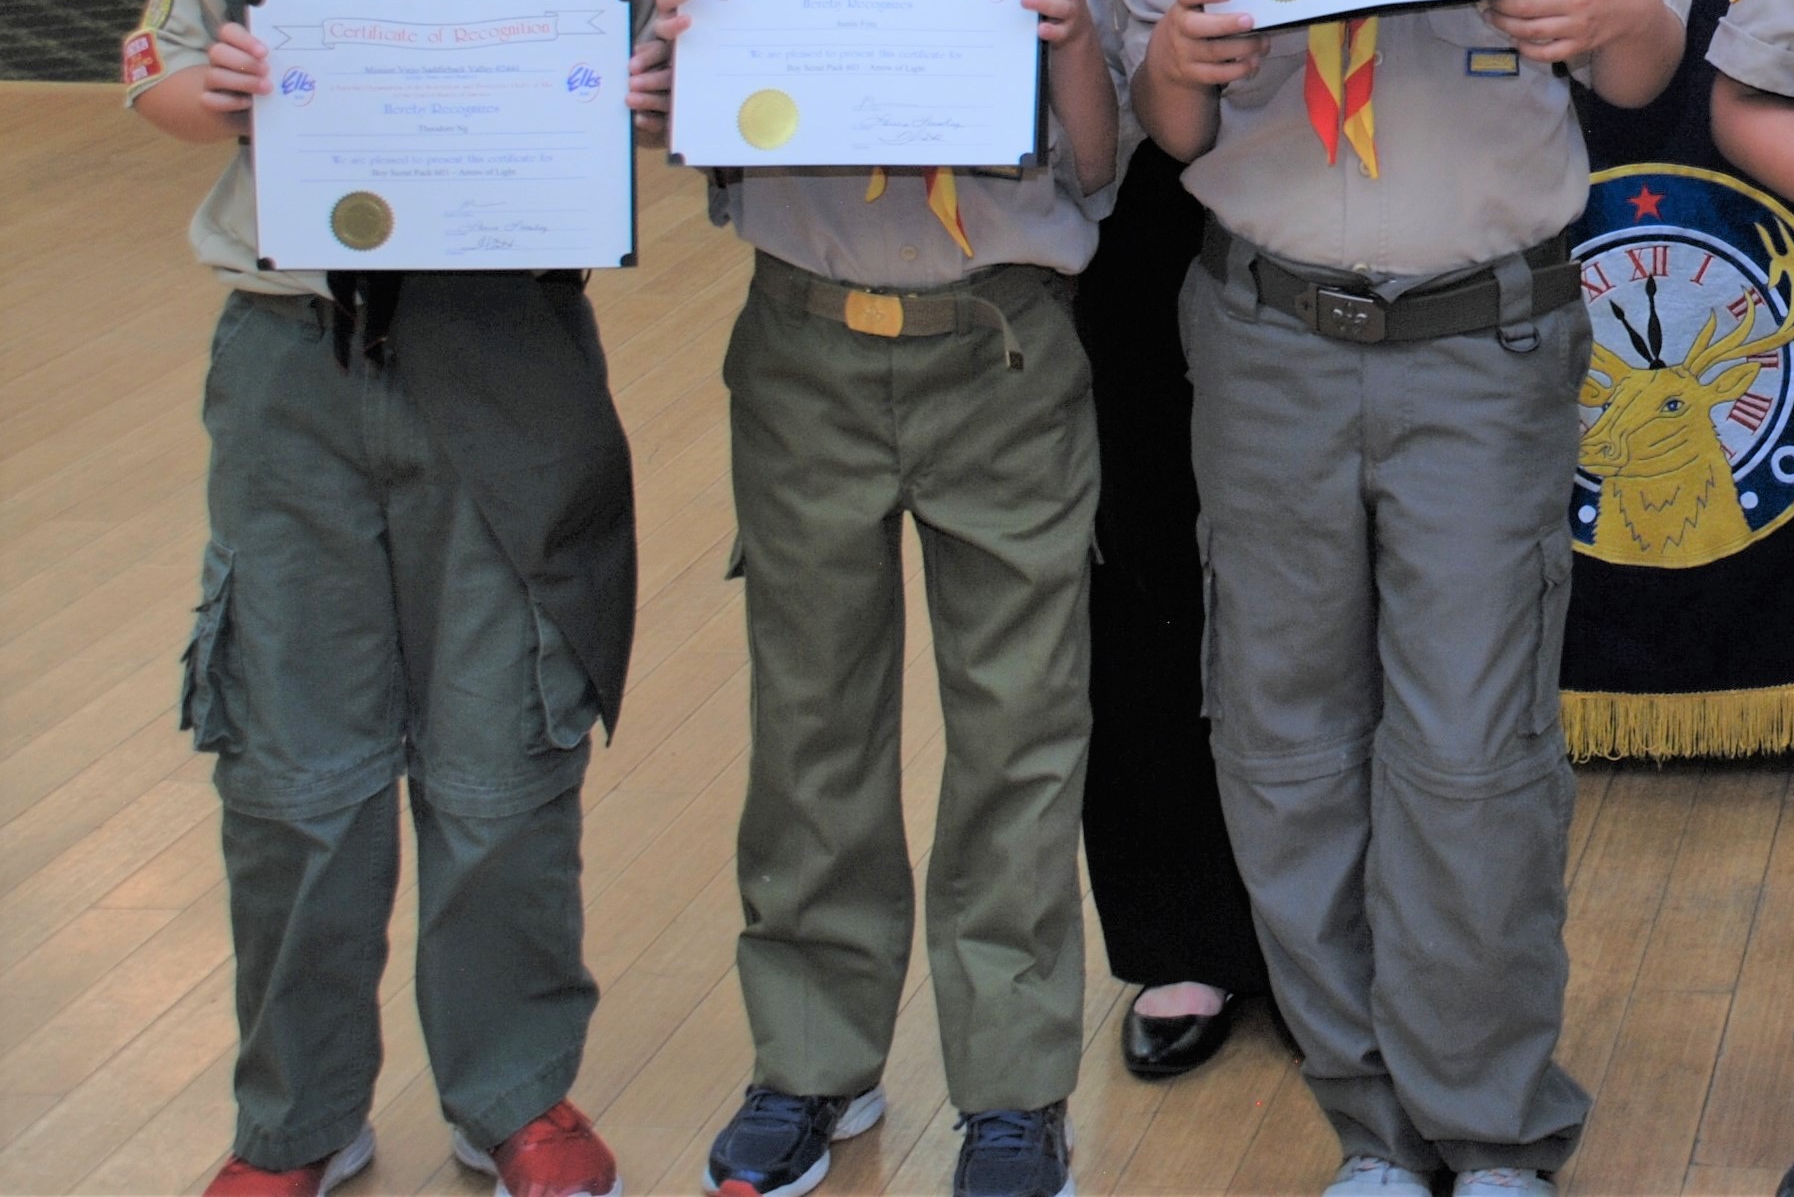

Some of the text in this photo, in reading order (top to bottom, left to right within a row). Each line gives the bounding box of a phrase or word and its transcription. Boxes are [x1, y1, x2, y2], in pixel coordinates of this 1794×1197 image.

[330, 22, 550, 43] Certificate of Recognition
[282, 71, 316, 96] Elks
[568, 68, 602, 93] Elks
[1625, 245, 1670, 282] XII
[1690, 253, 1716, 286] I
